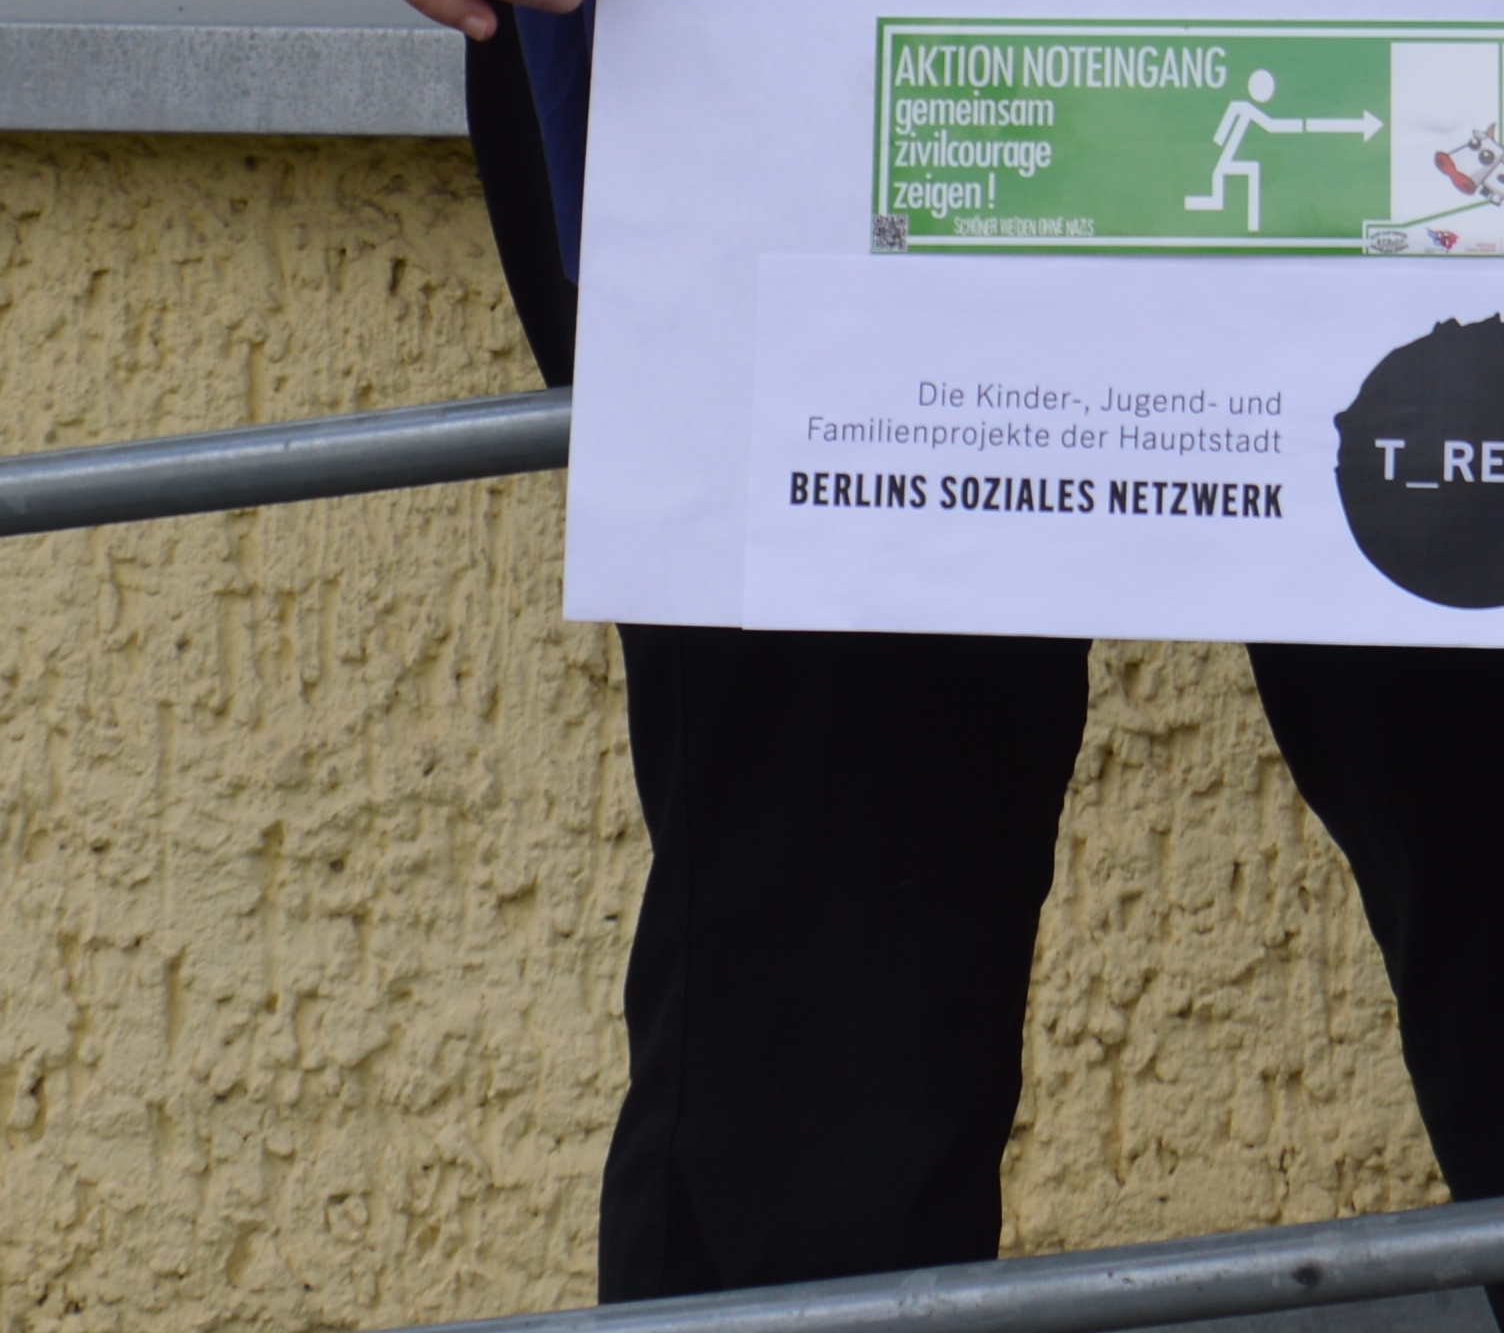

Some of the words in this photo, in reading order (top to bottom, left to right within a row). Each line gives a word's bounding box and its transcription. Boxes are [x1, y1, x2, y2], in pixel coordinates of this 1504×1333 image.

[895, 45, 1014, 88] AKTION
[1023, 46, 1227, 89] NOTEINGANG
[894, 90, 1055, 133] gemeinsam
[894, 129, 1052, 179] zivilcourage
[917, 380, 965, 410] Die
[975, 383, 1092, 418] Kinder-,
[1099, 385, 1218, 421] Jugend-
[1228, 389, 1283, 417] und
[806, 415, 1051, 454] Familienprojekte
[1060, 421, 1108, 450] der
[1117, 423, 1283, 458] Hauptstadt
[789, 470, 929, 510] BERLINS
[938, 473, 1096, 514] SOZIALES
[1107, 478, 1284, 520] NETZWERK
